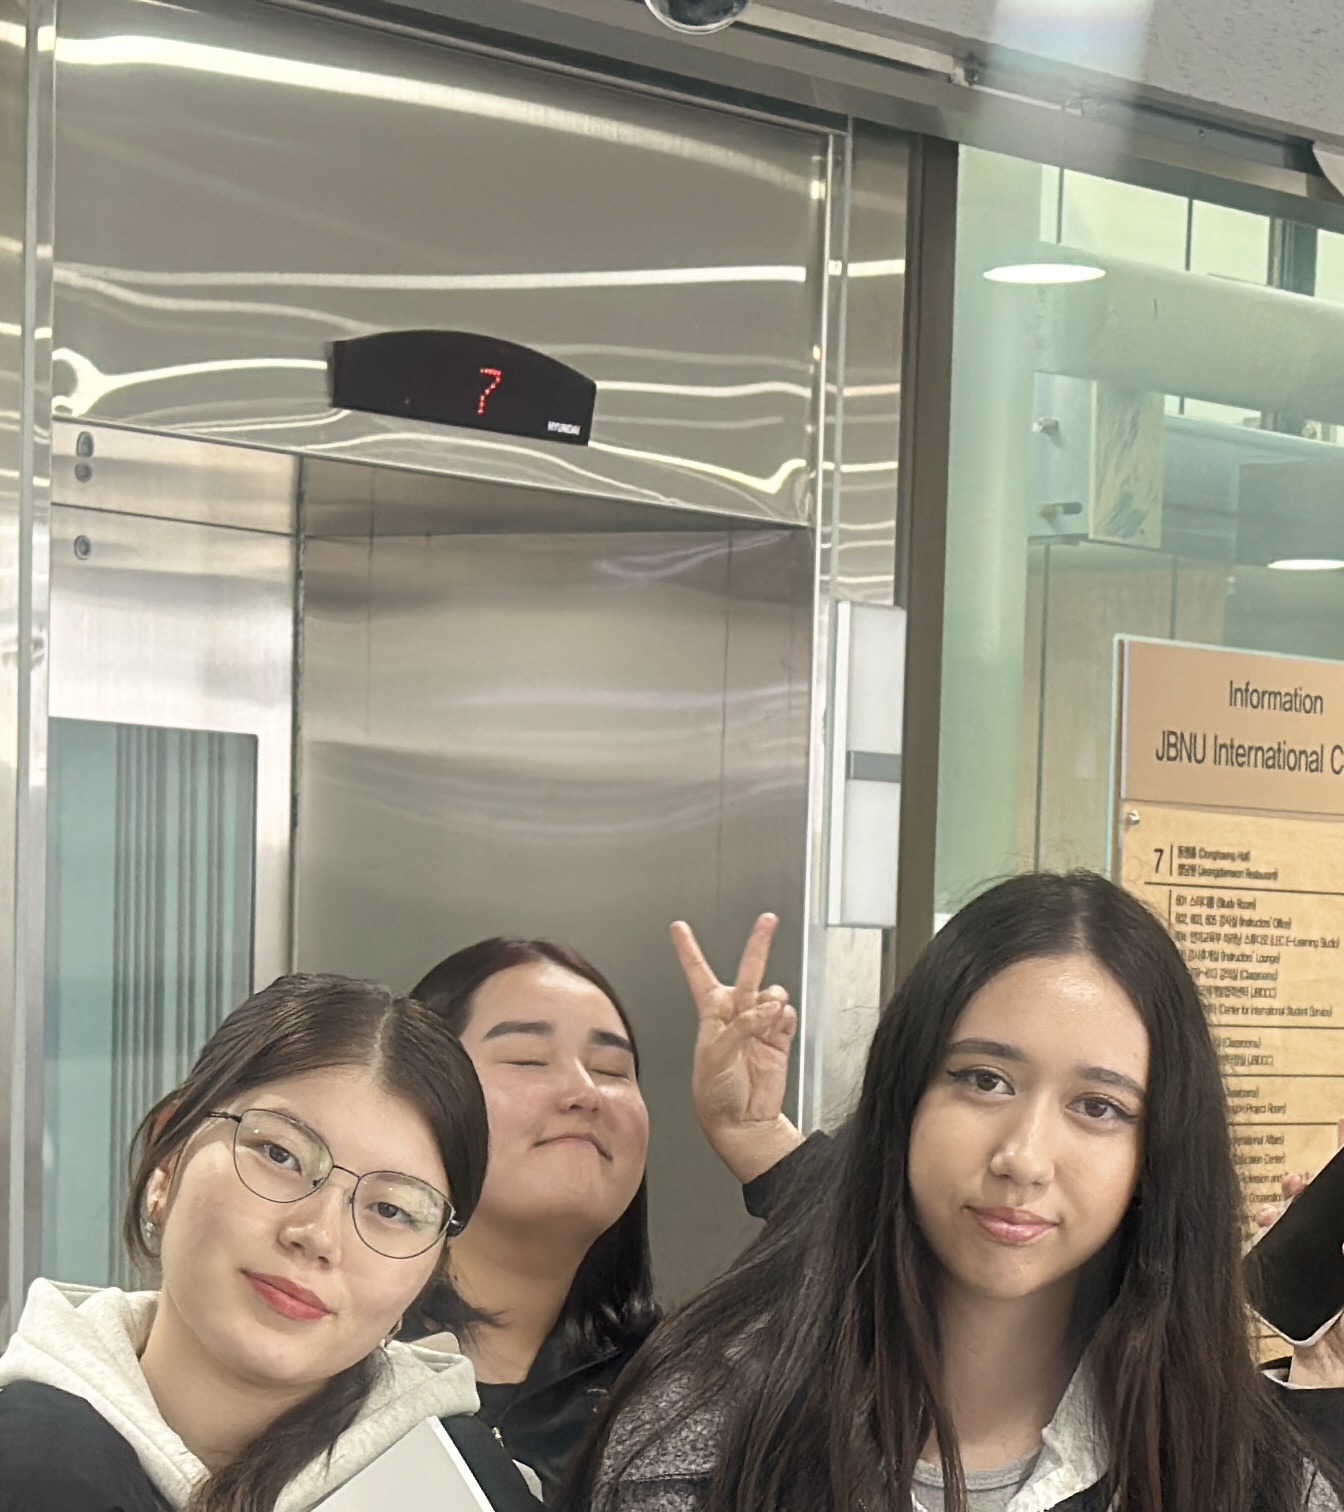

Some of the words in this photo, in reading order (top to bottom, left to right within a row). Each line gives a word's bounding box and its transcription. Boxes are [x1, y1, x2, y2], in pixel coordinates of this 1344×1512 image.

[478, 368, 502, 415] 7
[1229, 680, 1323, 715] Information
[1156, 730, 1207, 765] JBNU
[1213, 735, 1324, 775] International
[1154, 848, 1164, 874] 7
